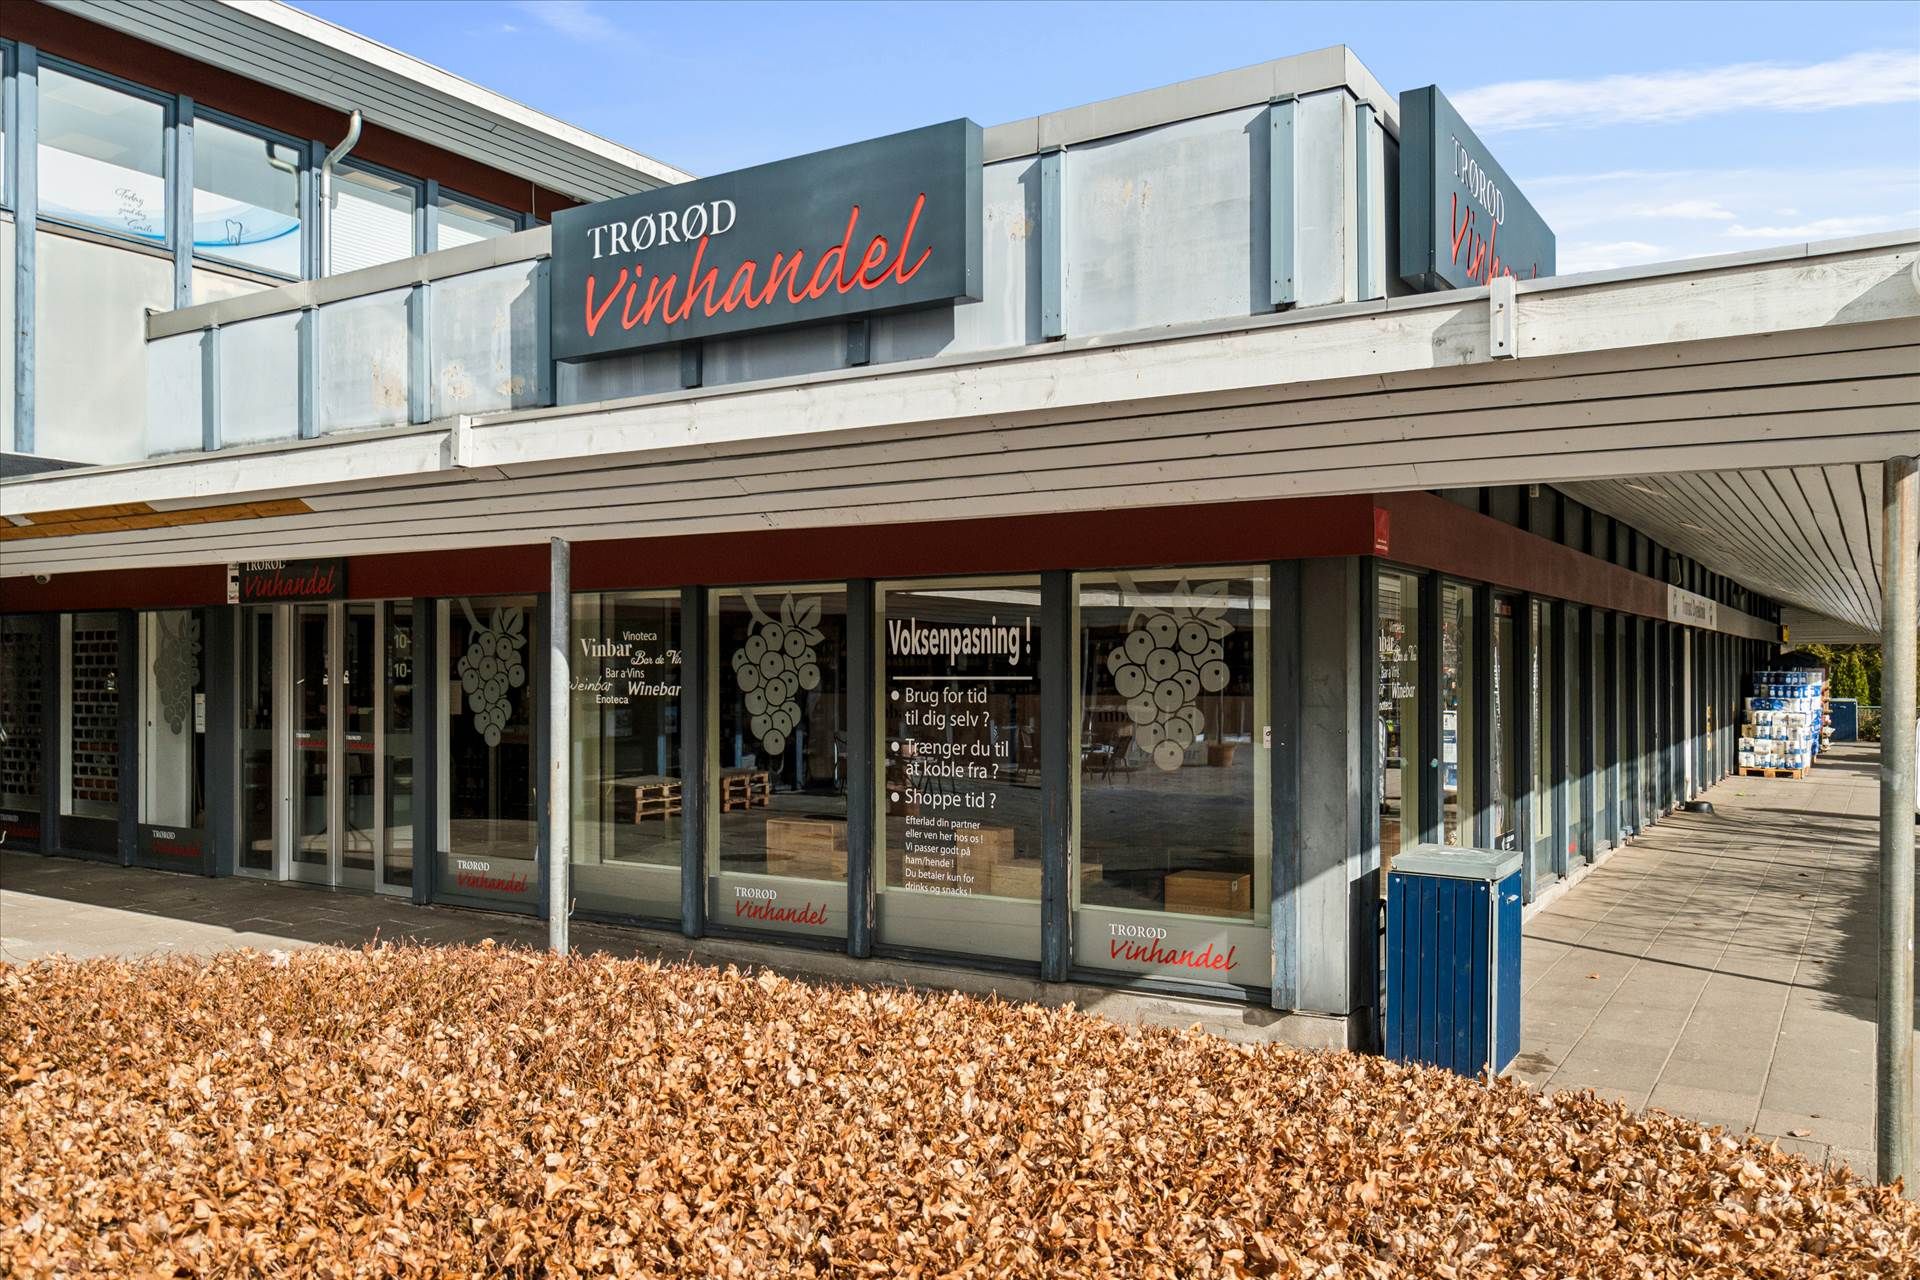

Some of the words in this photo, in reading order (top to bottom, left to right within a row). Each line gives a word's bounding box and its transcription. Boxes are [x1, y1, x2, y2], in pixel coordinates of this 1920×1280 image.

[1451, 134, 1505, 226] TRØRØD
[587, 199, 737, 260] TRØRØD
[584, 192, 933, 337] Vinhandel
[243, 564, 336, 598] Vinhandel
[622, 631, 657, 641] Vinoteca
[888, 615, 1020, 666] Voksenpasning
[1025, 616, 1031, 655] !
[581, 638, 633, 657] Vinbar
[630, 649, 653, 665] Bar
[654, 654, 665, 664] de
[605, 667, 619, 678] Bar
[627, 667, 645, 679] Vins
[628, 681, 682, 696] Winebar
[905, 687, 939, 707] Brug
[942, 686, 964, 703] for
[966, 686, 988, 704] tid
[596, 694, 629, 704] Enoteca
[905, 709, 919, 726] til
[922, 710, 946, 730] dig
[949, 710, 979, 727] selv
[982, 711, 990, 727] ?
[905, 738, 968, 759] Trænger
[970, 740, 990, 757] du
[994, 740, 1009, 757] til
[905, 761, 920, 776] at
[923, 760, 964, 778] koble
[967, 762, 988, 779] fra
[991, 763, 999, 779] ?
[905, 788, 962, 810] Shoppe
[964, 792, 985, 808] tid
[988, 793, 997, 809] ?
[905, 815, 936, 827] Efterlad
[936, 817, 949, 828] din
[950, 822, 981, 830] partner
[905, 829, 922, 839] eller
[923, 832, 938, 840] ven
[939, 831, 953, 841] her
[954, 832, 968, 843] hos
[969, 835, 980, 844] os
[905, 841, 913, 851] Vi
[914, 844, 939, 853] passer
[940, 845, 960, 856] godt
[960, 846, 971, 858] på
[457, 860, 490, 871] TRØRØD
[905, 854, 951, 868] ham/hende
[905, 867, 917, 878] Du
[918, 869, 946, 881] betaler
[946, 871, 962, 882] kun
[963, 873, 976, 884] for
[735, 886, 777, 900] TRØRØD
[905, 881, 928, 892] drinks
[929, 885, 941, 896] og
[941, 886, 968, 897] snacks
[735, 899, 828, 924] Vinhandel
[1109, 923, 1167, 939] TRØRØD
[1110, 938, 1240, 972] Vinhandel
